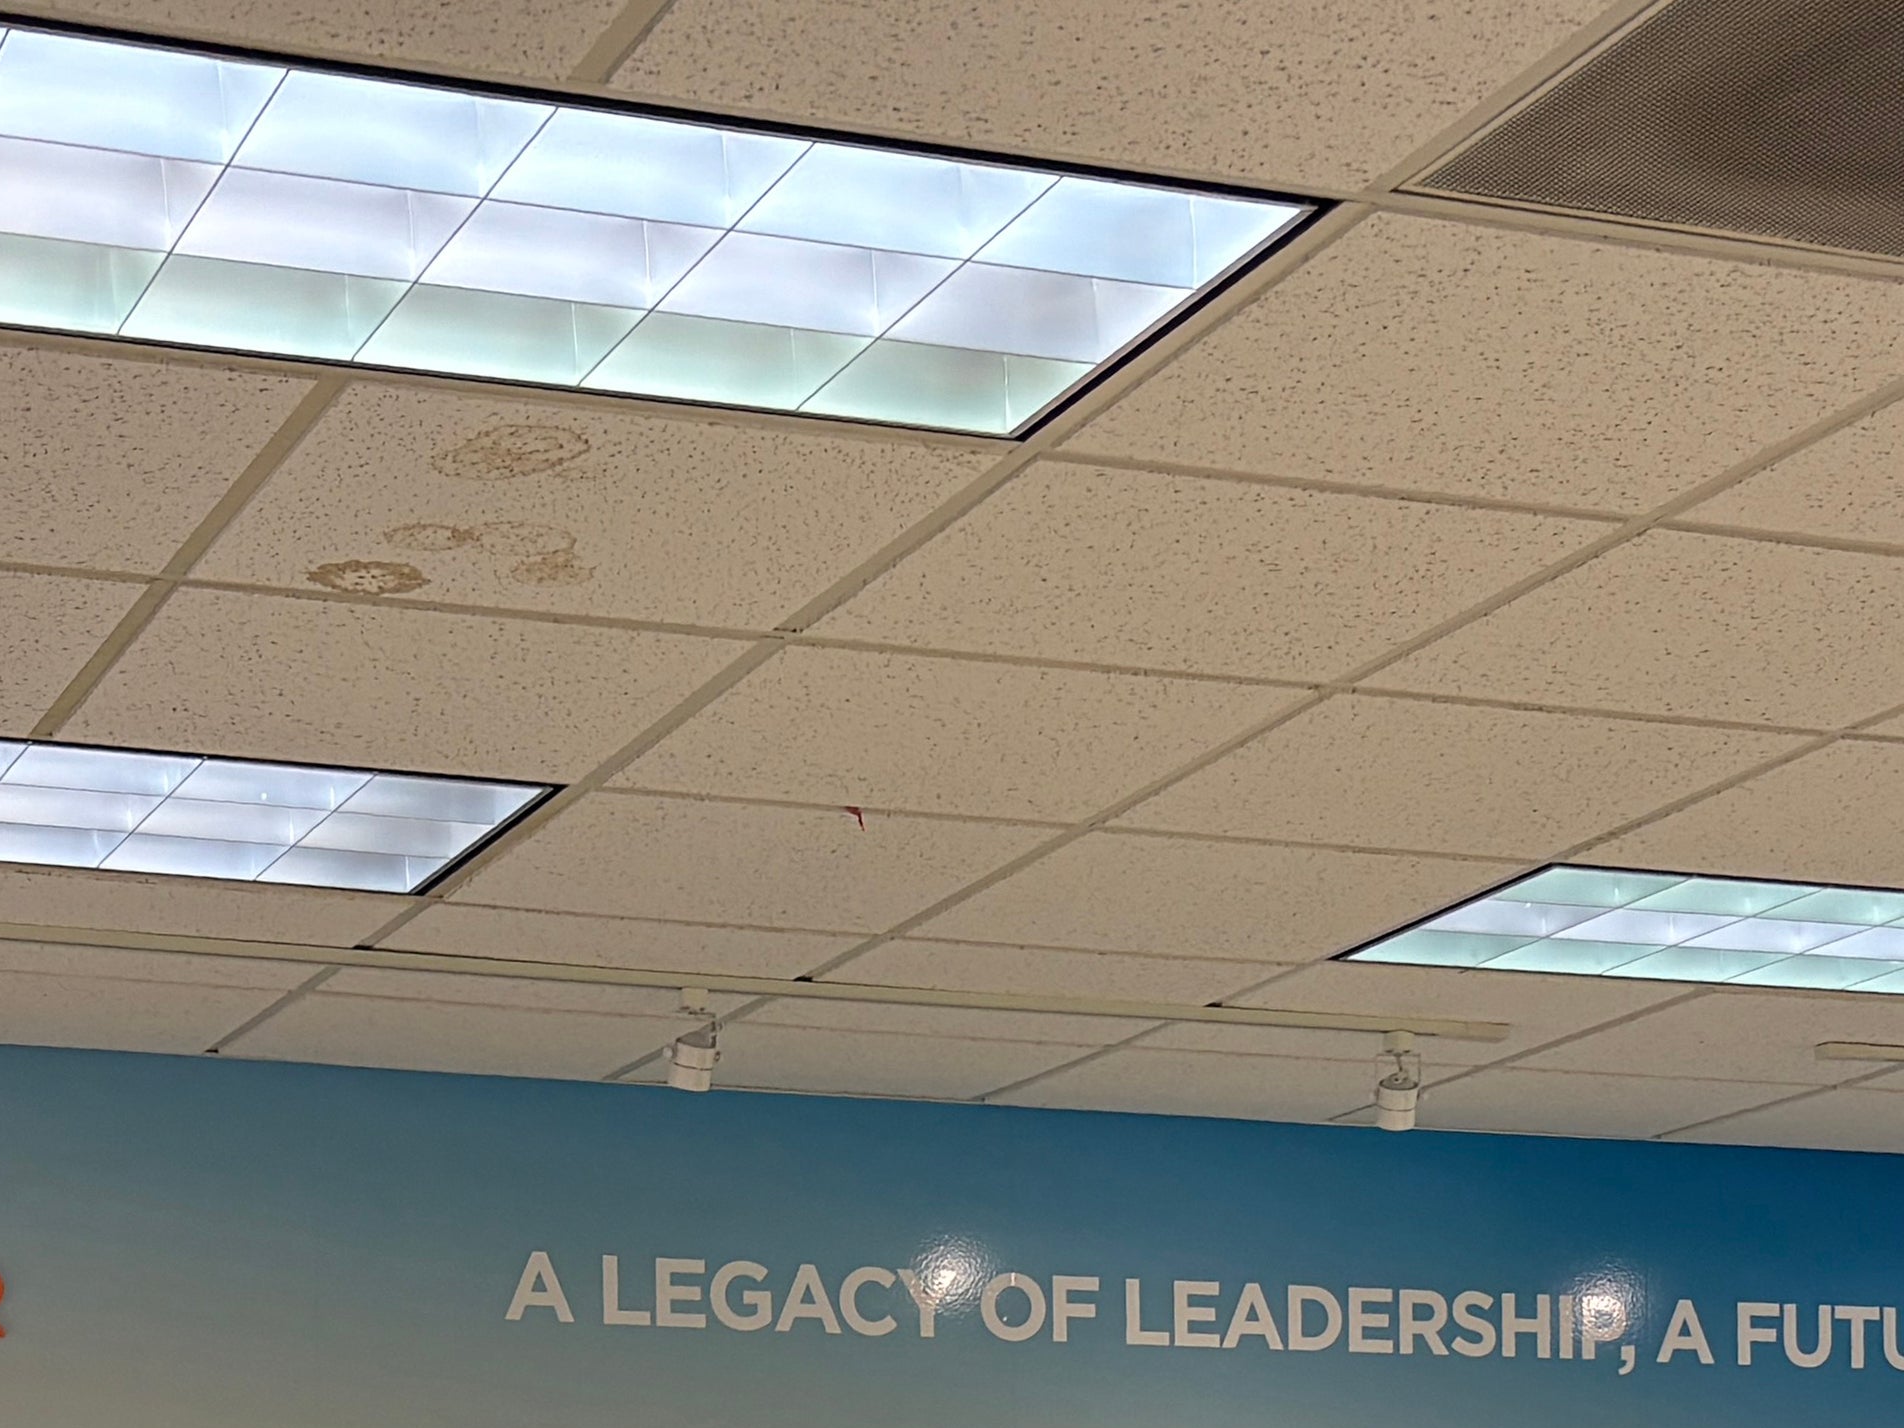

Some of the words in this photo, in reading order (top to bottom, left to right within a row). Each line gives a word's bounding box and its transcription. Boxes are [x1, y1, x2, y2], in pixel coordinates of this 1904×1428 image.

[505, 1251, 575, 1323] A
[602, 1254, 957, 1338] LEGACY
[980, 1272, 1100, 1343] OF
[1125, 1278, 1636, 1375] LEADERSHIP,
[1656, 1299, 1715, 1365] A
